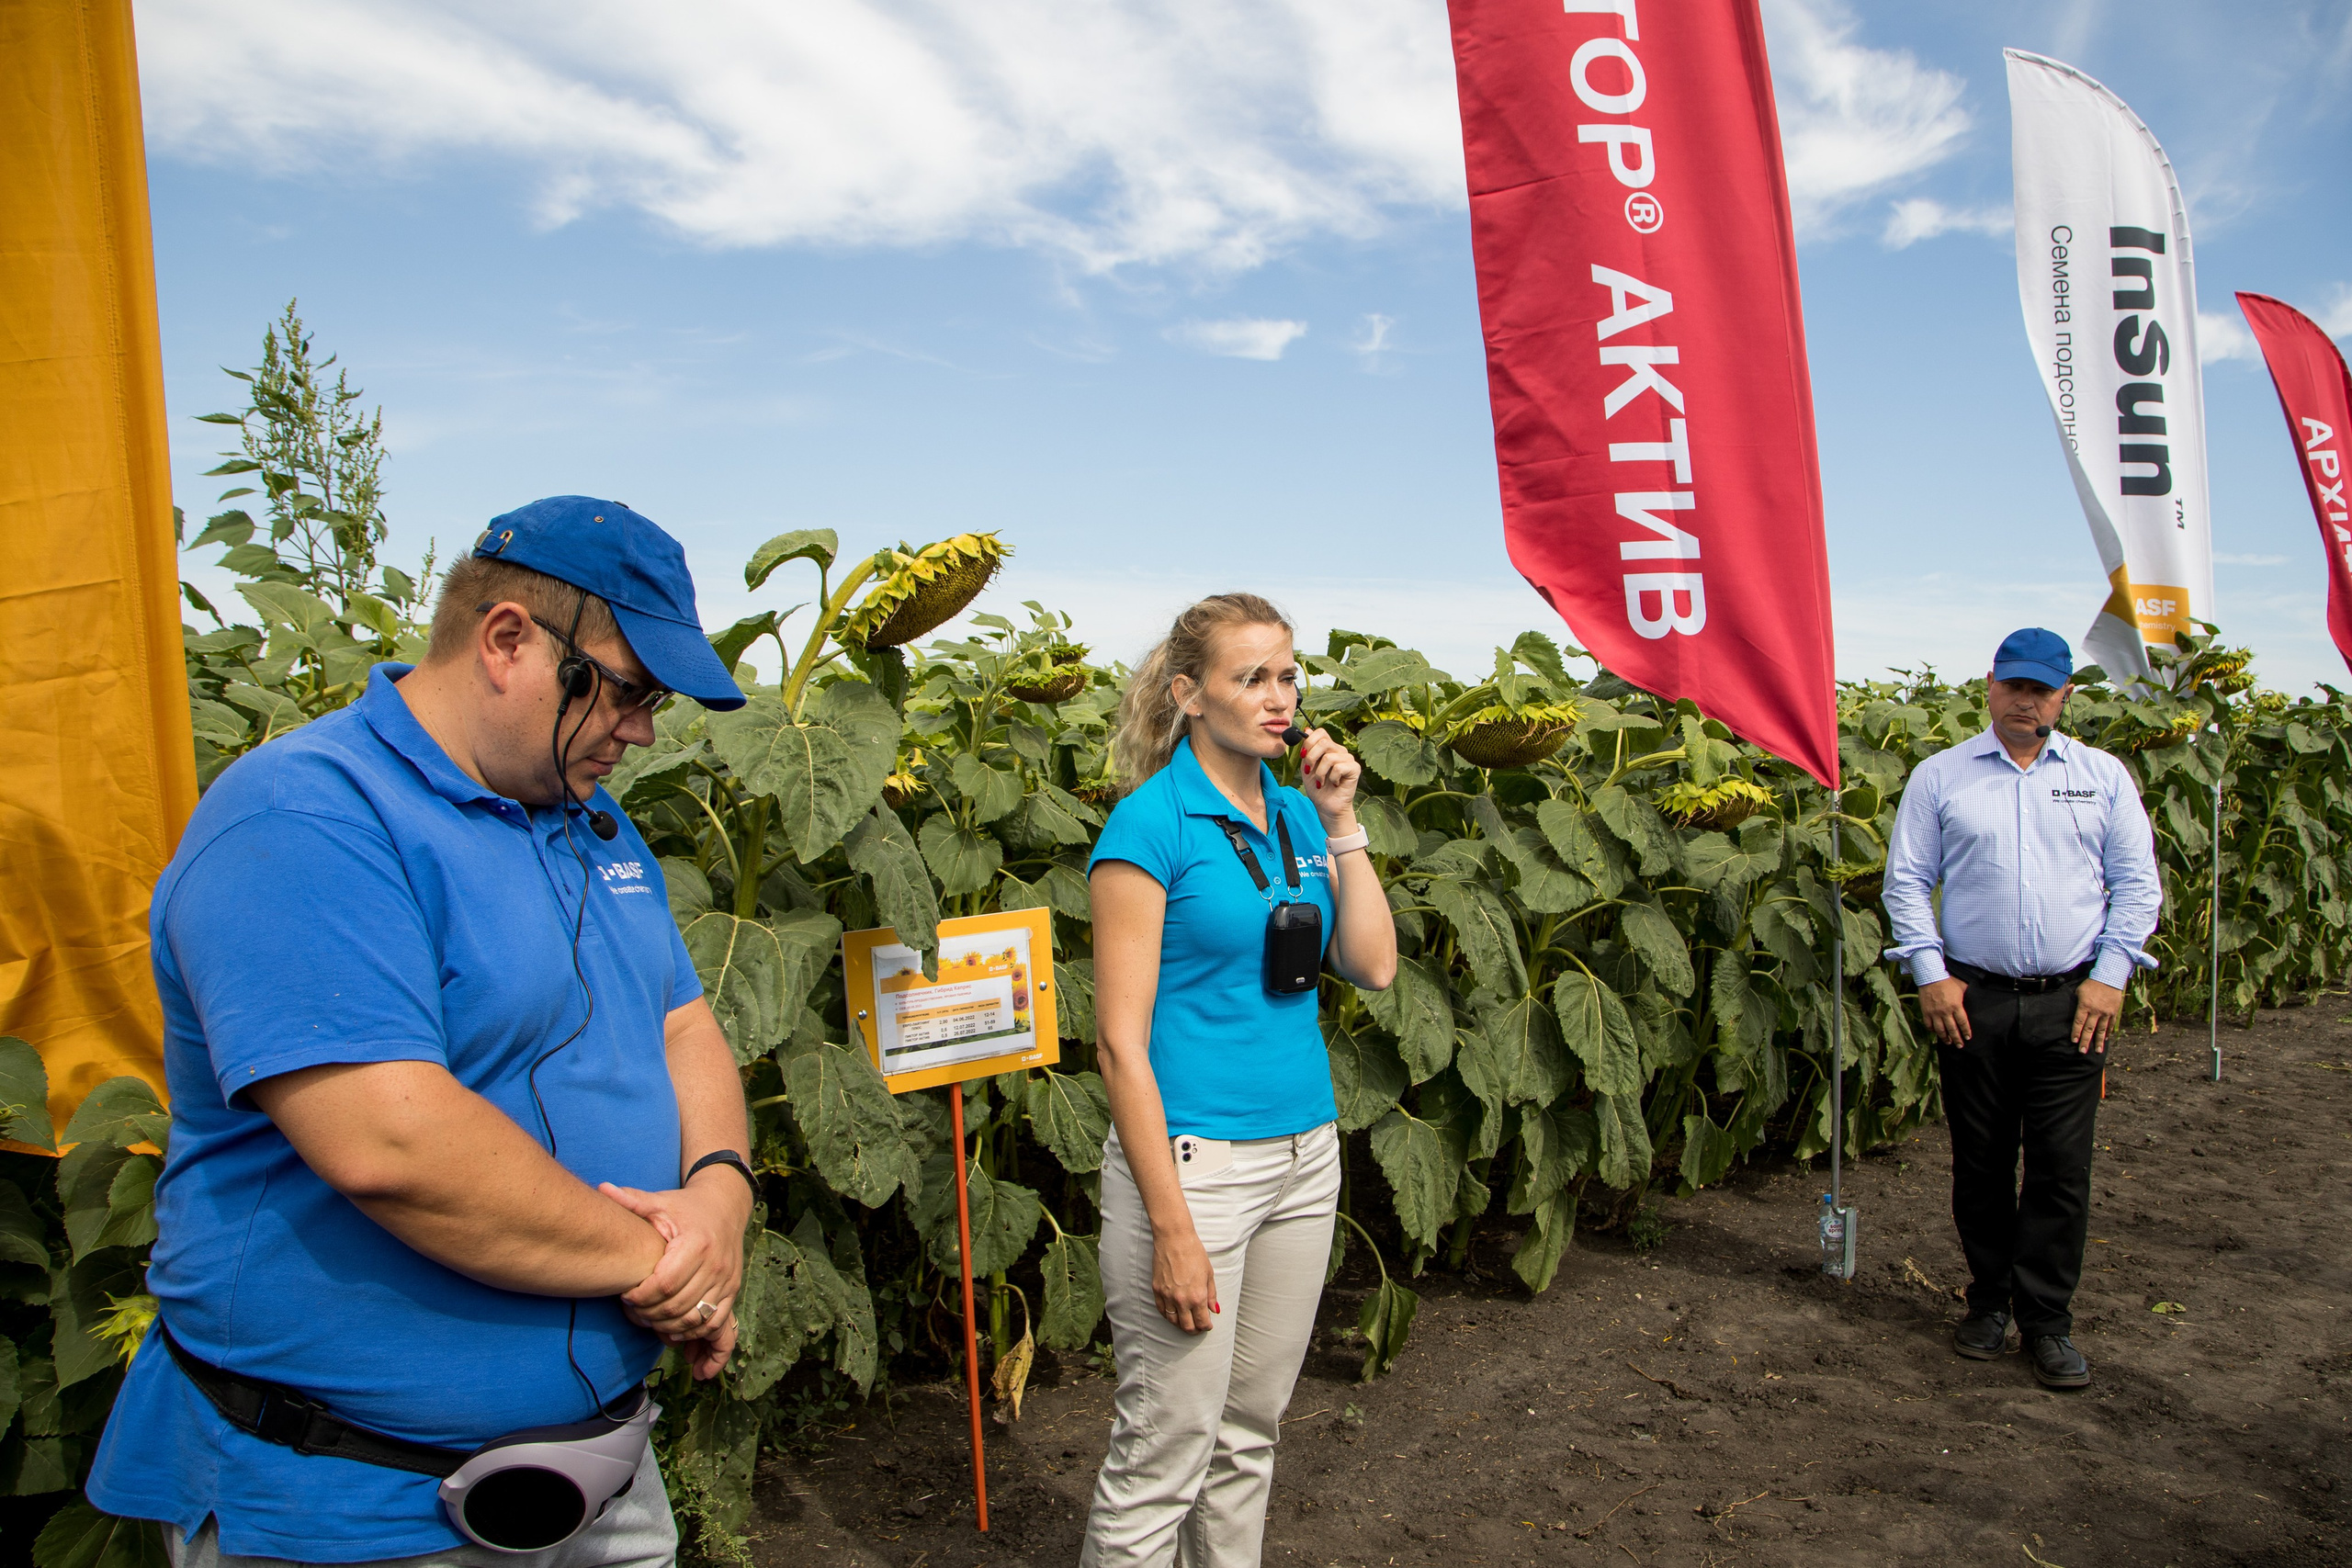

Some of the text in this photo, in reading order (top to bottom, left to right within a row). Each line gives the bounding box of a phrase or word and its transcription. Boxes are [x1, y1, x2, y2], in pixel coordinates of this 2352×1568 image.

[2051, 225, 2079, 457] Семена подсолне
[1590, 263, 1707, 640] АКТИВ
[2135, 598, 2177, 616] ASF
[2067, 790, 2096, 798] BASF
[1312, 855, 1328, 868] BA
[611, 862, 643, 879] BASF
